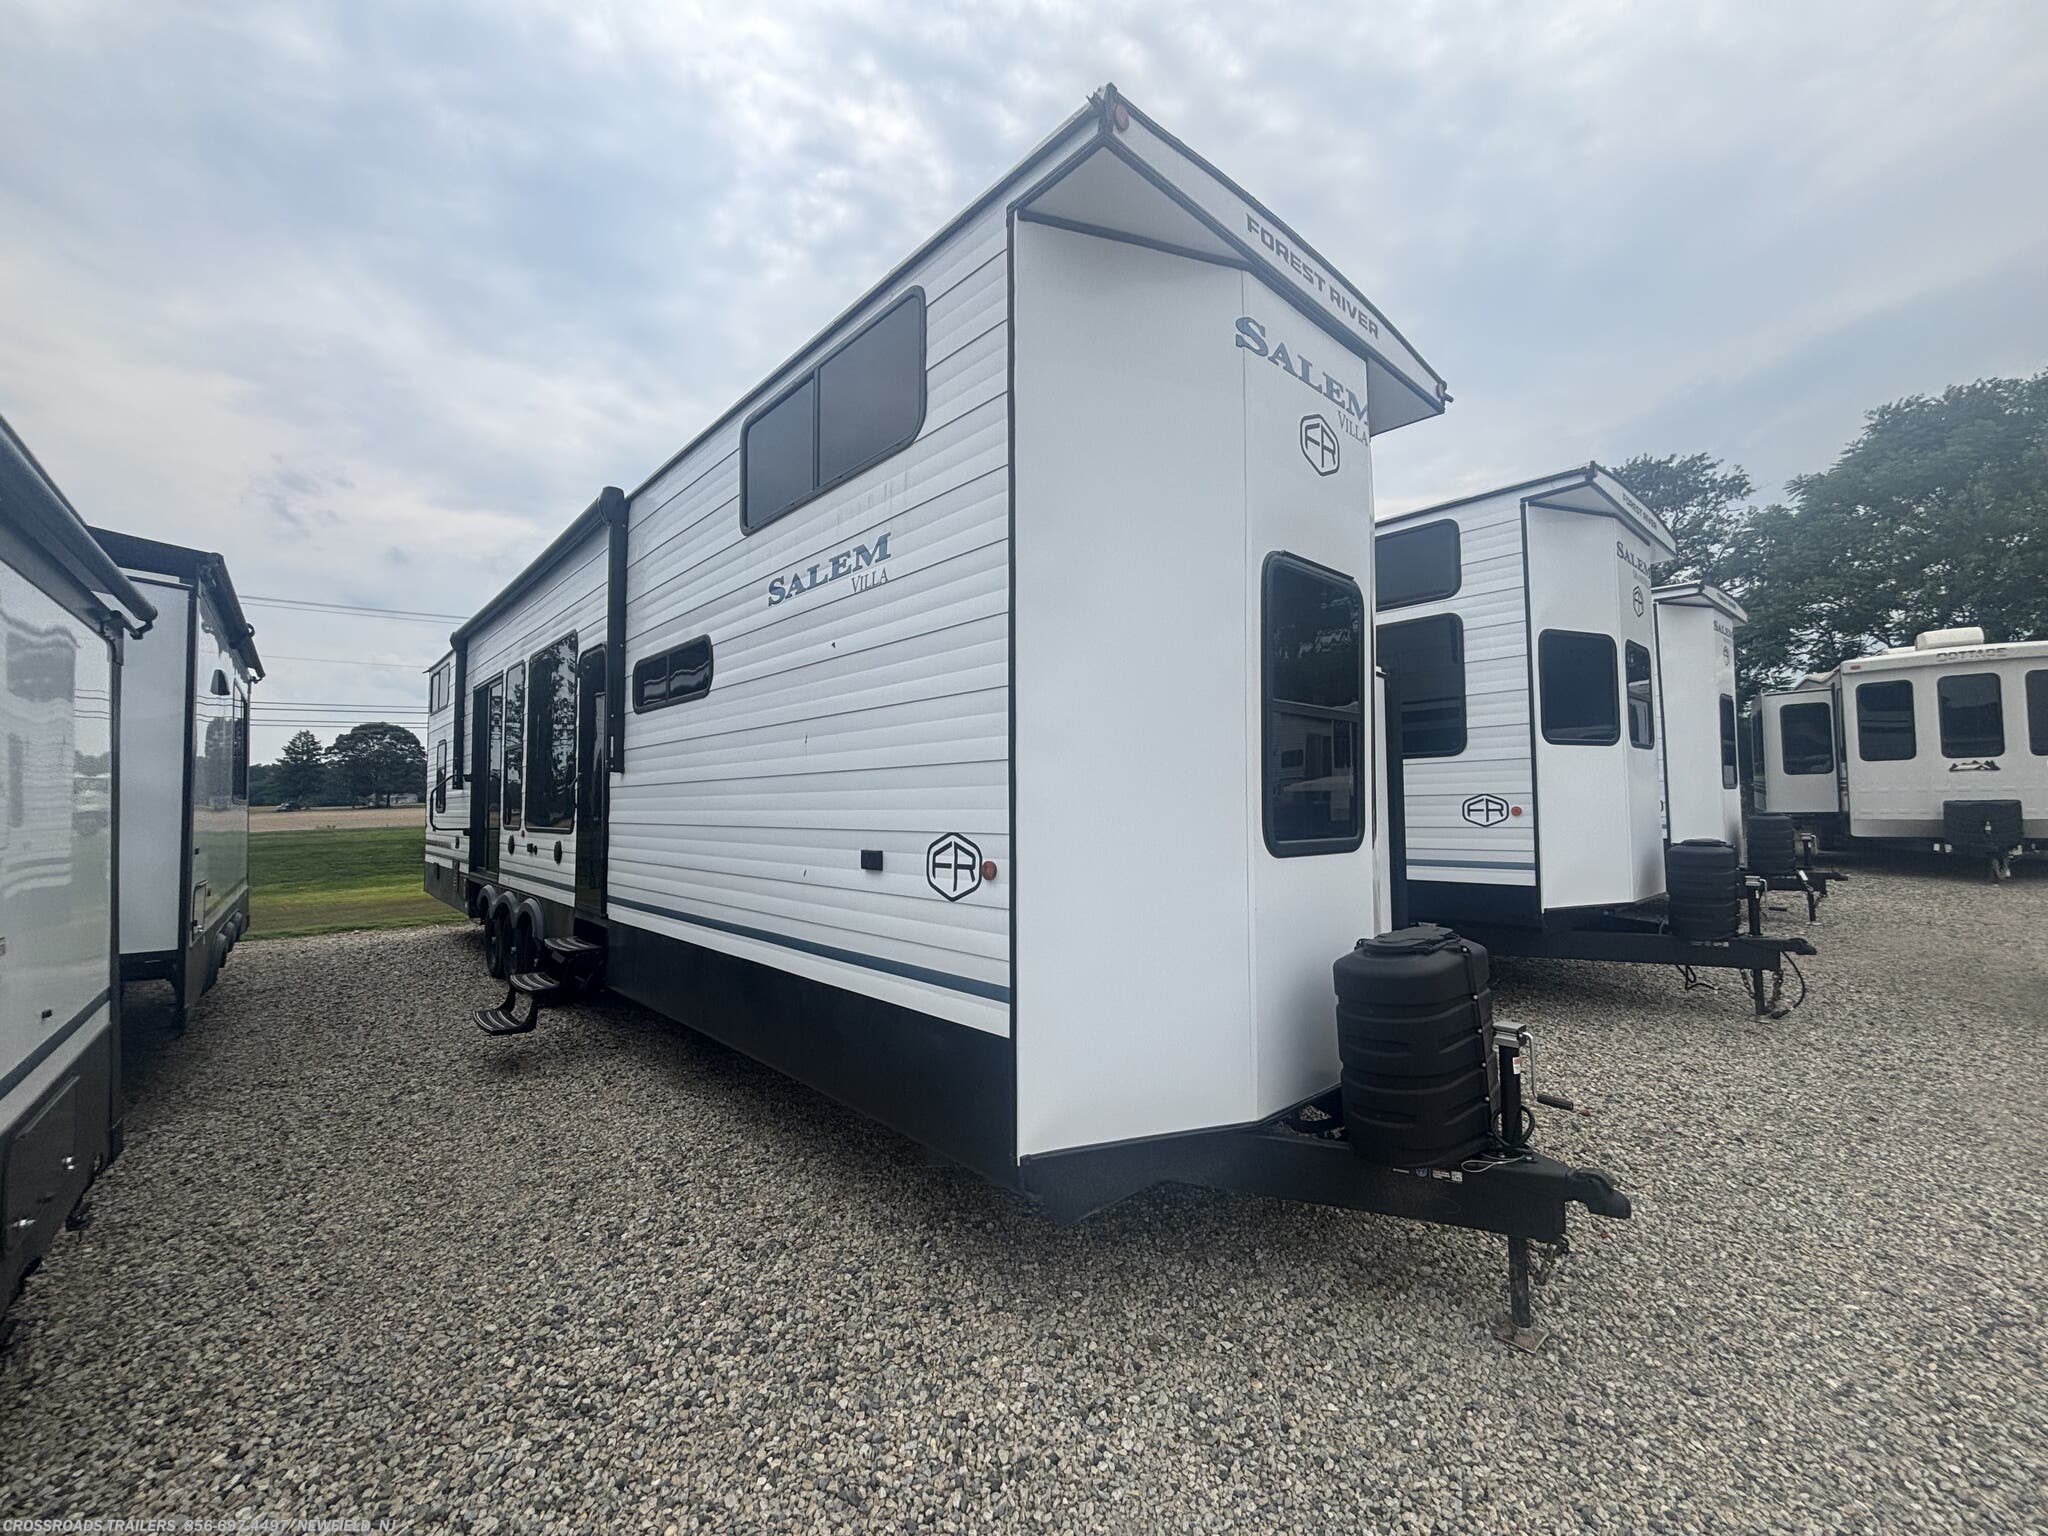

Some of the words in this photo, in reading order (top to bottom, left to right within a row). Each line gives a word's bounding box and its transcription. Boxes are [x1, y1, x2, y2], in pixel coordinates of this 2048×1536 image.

[1246, 213, 1325, 292] FOREST
[1330, 289, 1379, 340] RIVER
[1235, 316, 1368, 425] SALEM
[1338, 409, 1369, 447] VILLA
[768, 532, 892, 607] SALEM
[851, 567, 889, 593] VILLA
